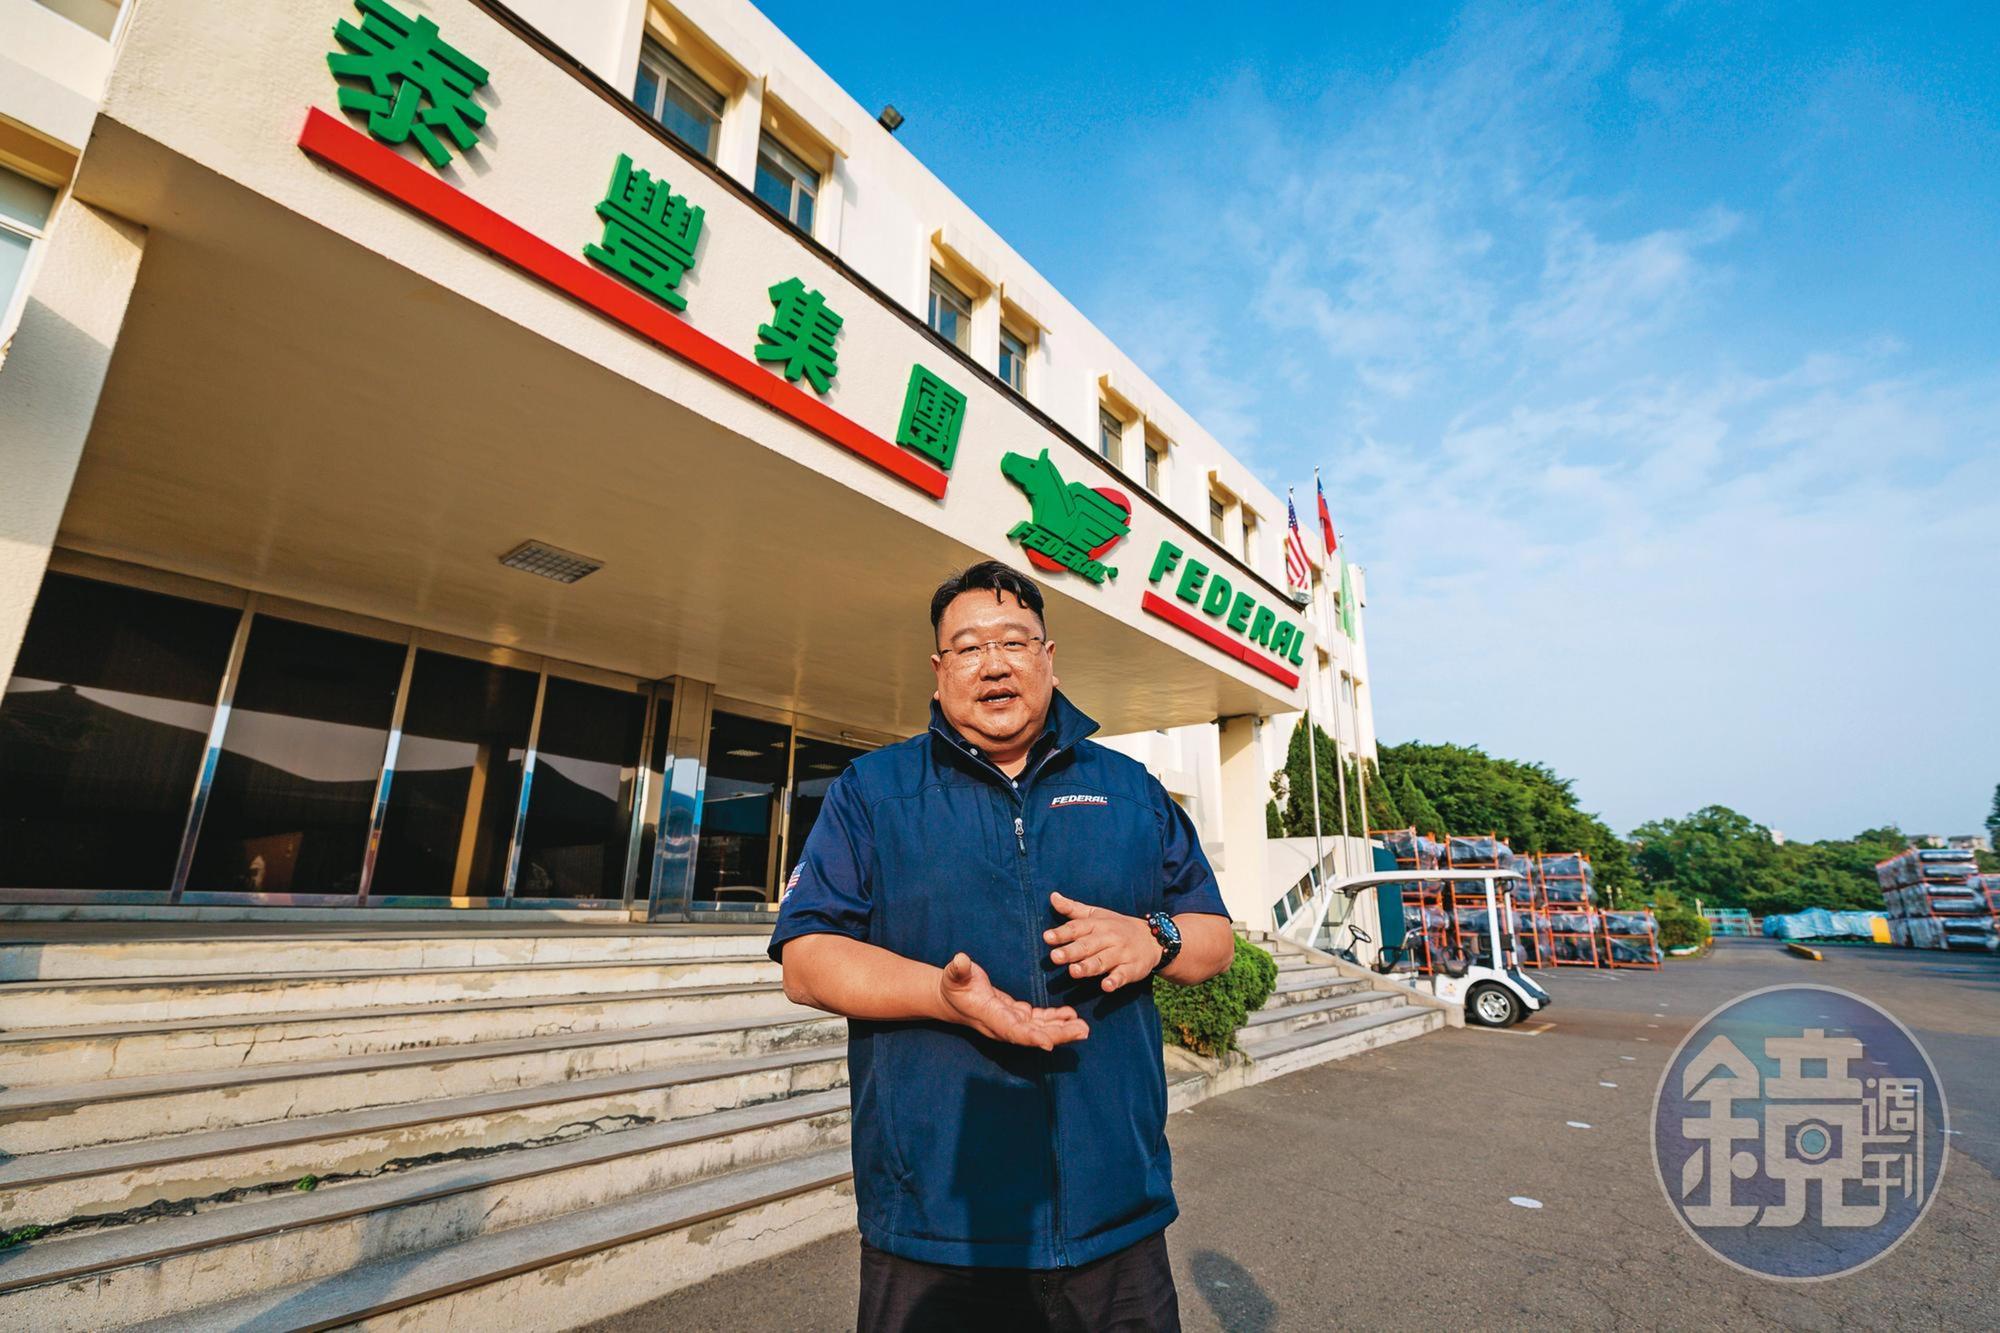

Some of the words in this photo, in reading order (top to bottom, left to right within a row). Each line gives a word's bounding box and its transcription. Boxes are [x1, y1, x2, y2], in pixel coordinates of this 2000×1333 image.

[326, 0, 968, 471] 泰豐集團
[1006, 520, 1106, 585] FEDERAL
[1148, 540, 1305, 667] FEDERAL
[1051, 794, 1108, 806] FEDERAL
